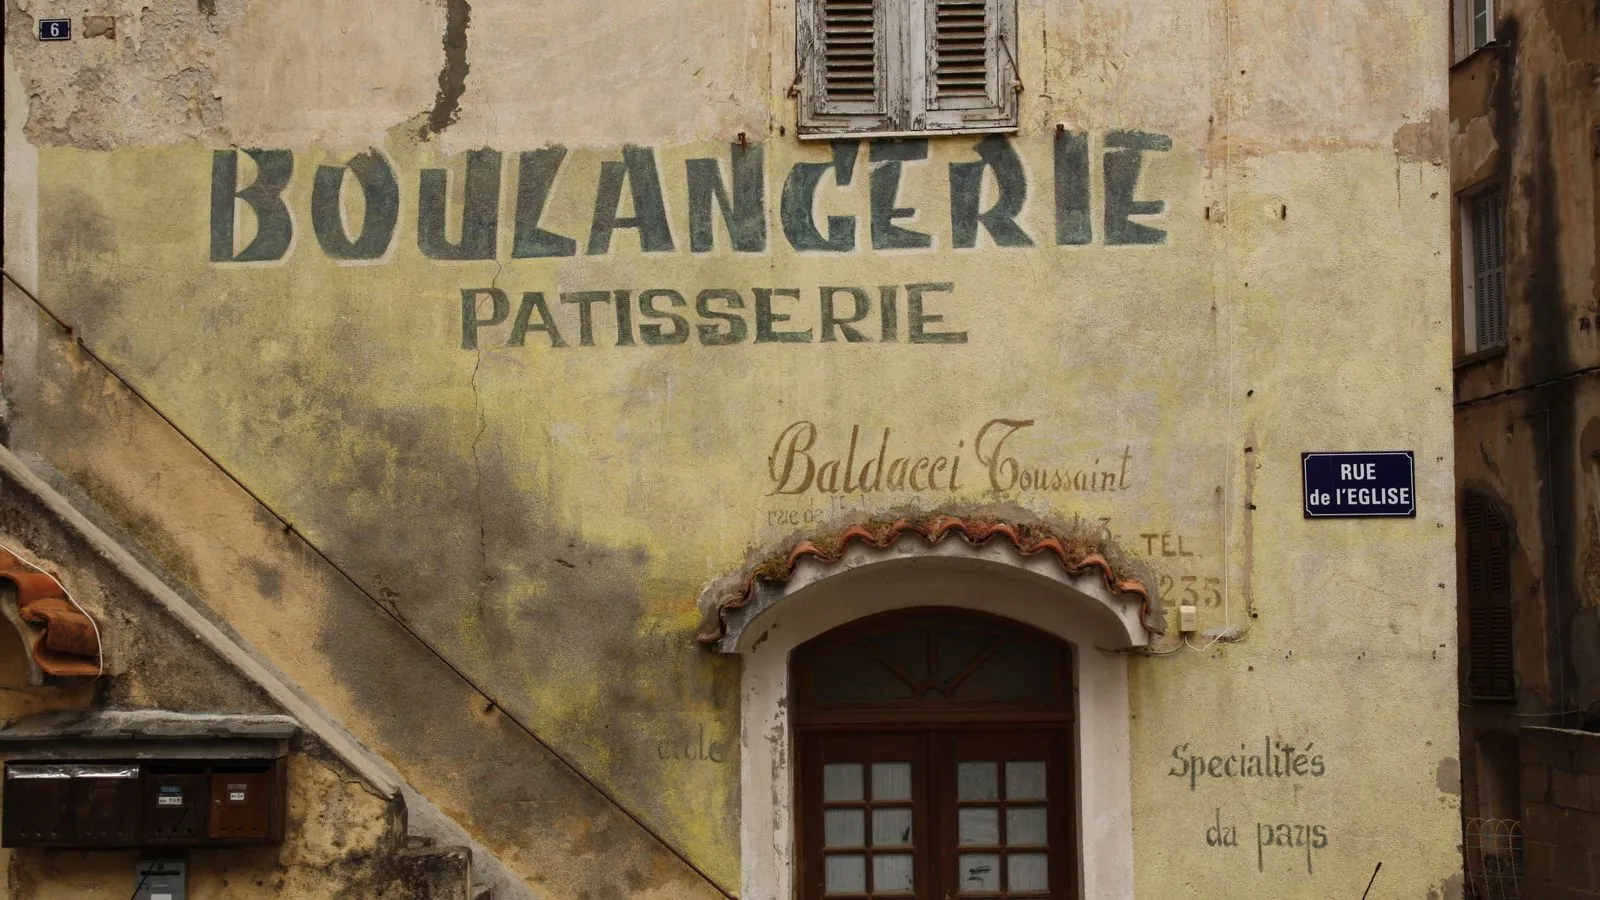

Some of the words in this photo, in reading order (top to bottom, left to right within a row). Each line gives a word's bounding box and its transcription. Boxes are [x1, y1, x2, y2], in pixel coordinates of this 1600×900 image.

[50, 22, 60, 37] 6
[210, 130, 1173, 264] BOULANGERIE
[460, 281, 968, 350] PATISSERIE
[764, 420, 964, 498] Baldacci
[974, 418, 1133, 493] Toussaint
[1341, 463, 1376, 480] RUE
[768, 509, 800, 527] rue
[1310, 489, 1331, 506] de
[1337, 487, 1410, 506] l'EGLISE
[1206, 807, 1238, 848] du
[1257, 822, 1329, 875] pays
